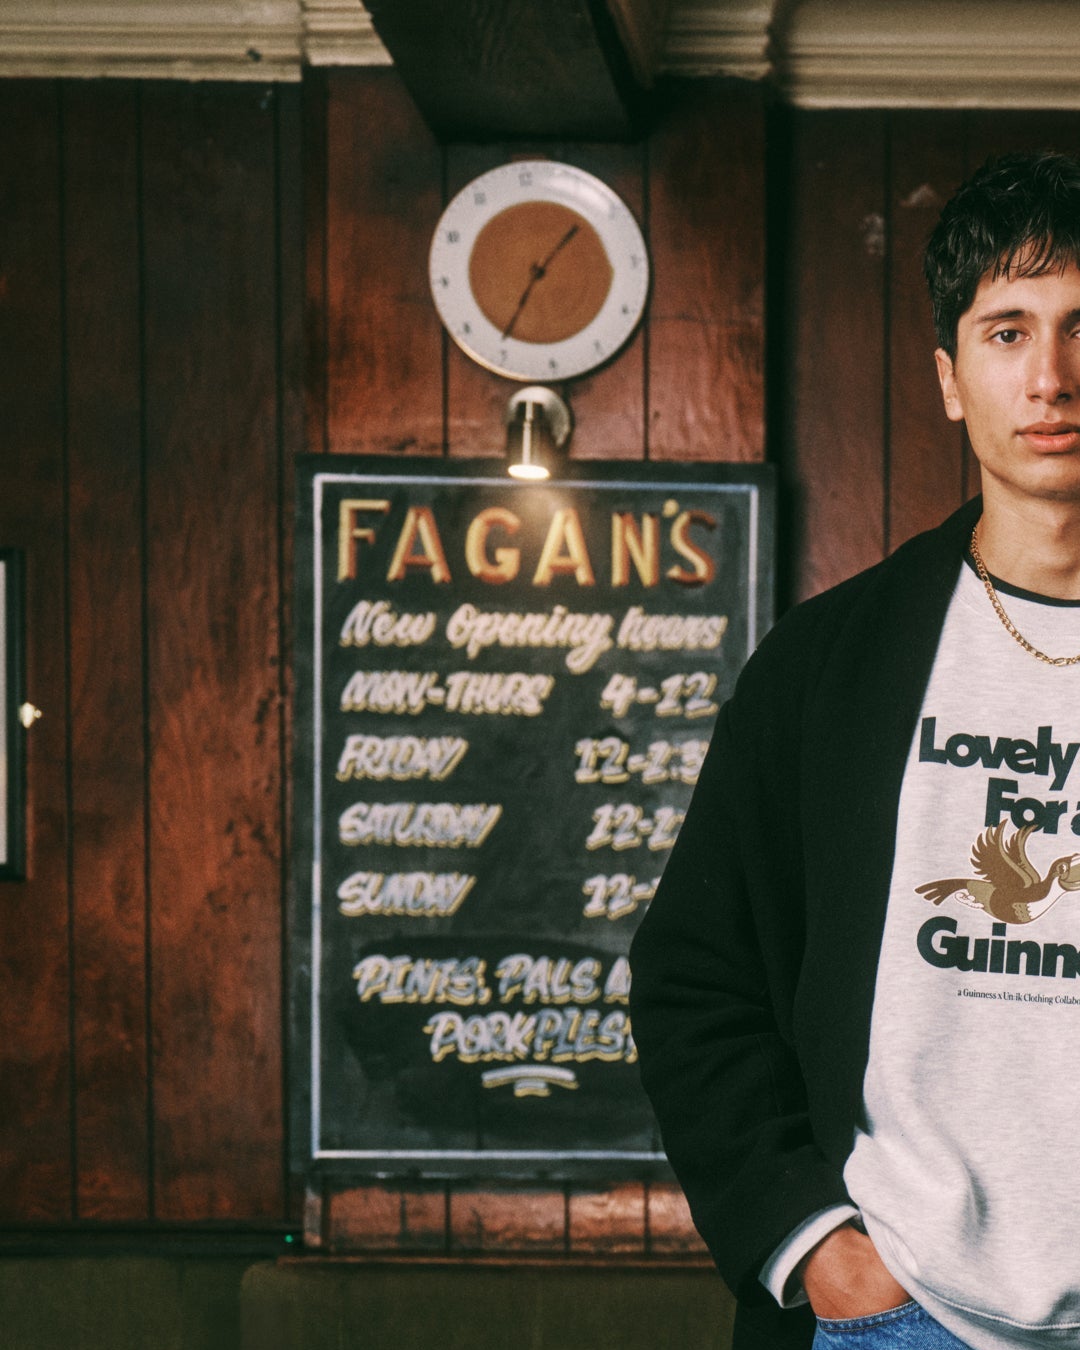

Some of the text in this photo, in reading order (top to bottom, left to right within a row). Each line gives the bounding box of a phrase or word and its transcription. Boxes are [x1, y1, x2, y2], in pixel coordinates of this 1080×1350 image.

[337, 498, 717, 588] FAGAN'S
[339, 600, 437, 647] New
[446, 602, 614, 675] Opening
[340, 670, 720, 720] MON-THURS 4-12
[335, 734, 469, 782] FRIDAY
[919, 716, 1080, 791] Lovely
[338, 802, 503, 848] SATURDAY
[984, 777, 1068, 835] For
[337, 871, 477, 917] SUNDAY
[495, 953, 602, 1004] PALS
[963, 988, 997, 999] Guinness
[1023, 993, 1053, 1006] Clothing
[423, 1010, 536, 1063] PORK
